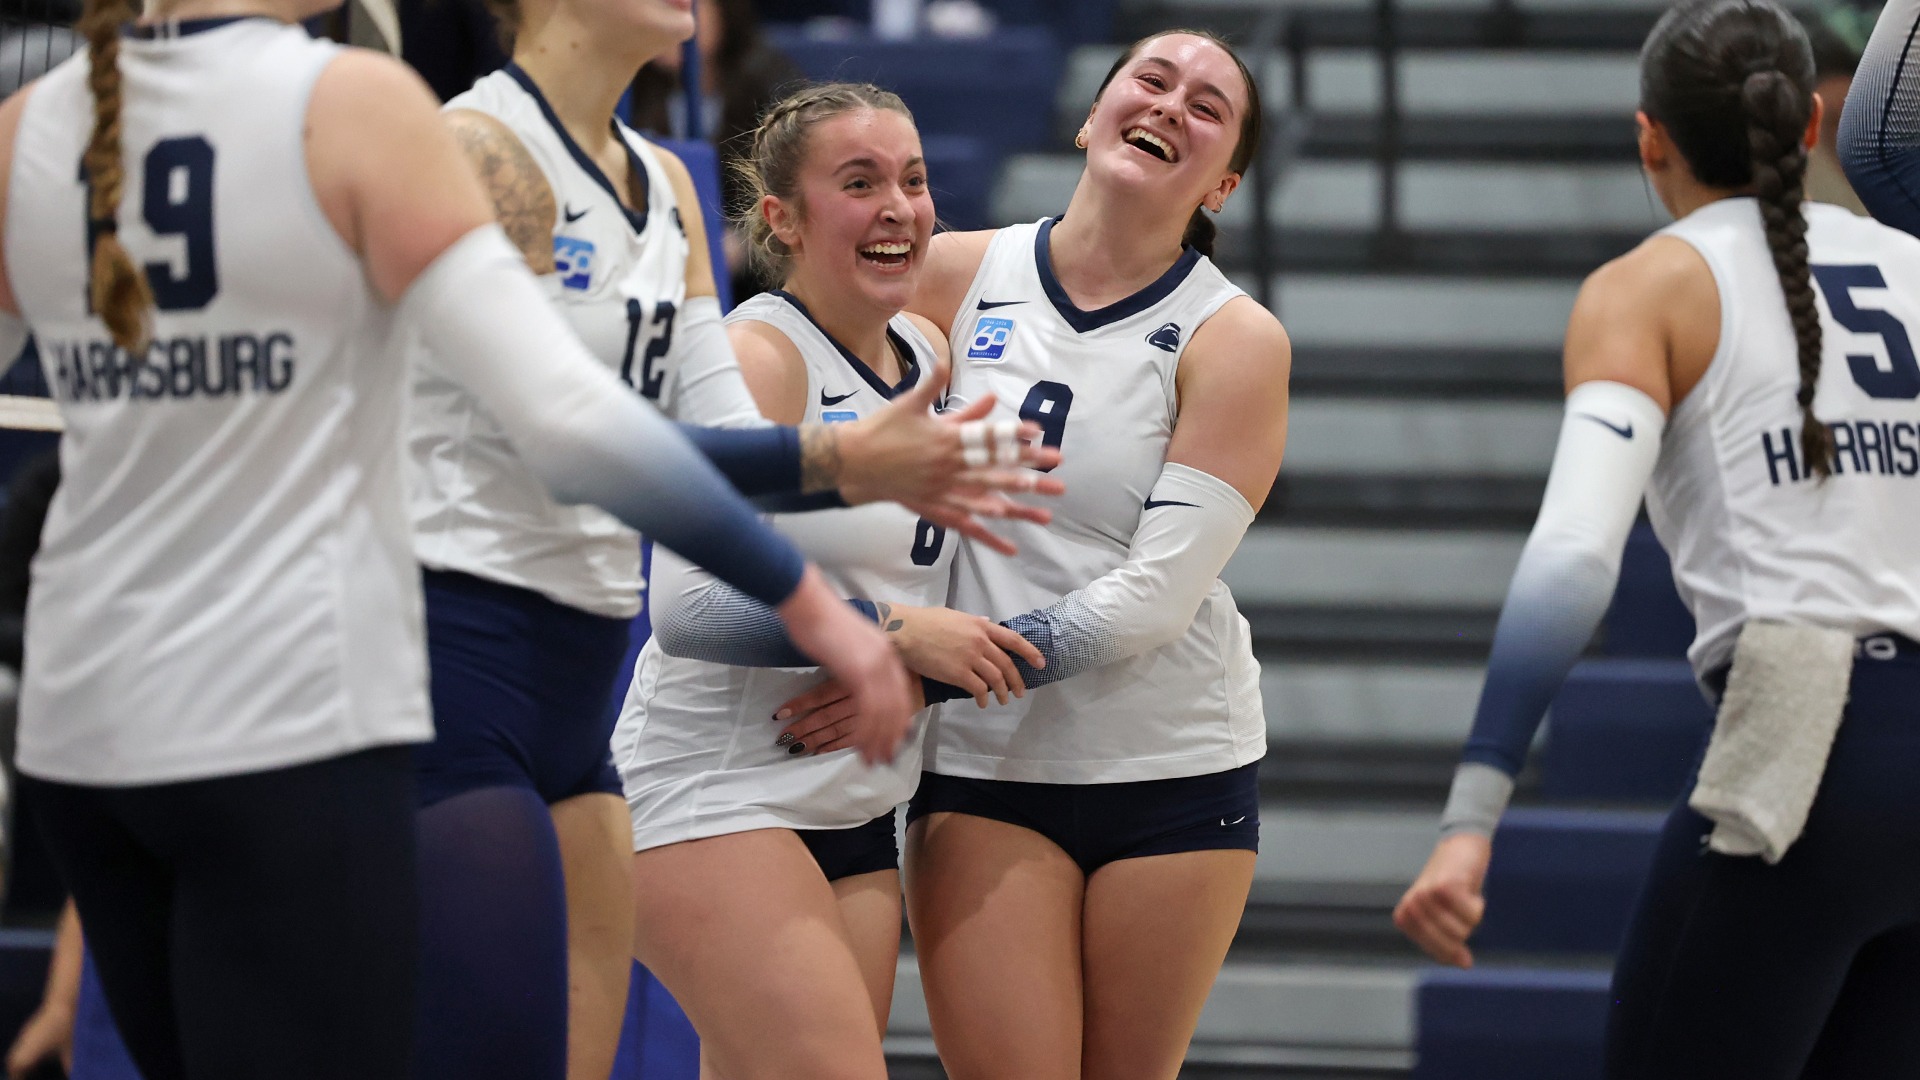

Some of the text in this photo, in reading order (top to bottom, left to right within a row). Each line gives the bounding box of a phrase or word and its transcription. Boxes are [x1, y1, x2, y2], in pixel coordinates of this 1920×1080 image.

[77, 135, 218, 314] 9
[620, 298, 676, 398] 12
[970, 325, 1010, 351] 60
[1811, 265, 1920, 399] 5
[1018, 380, 1074, 473] 9
[1763, 421, 1920, 485] HRRIS
